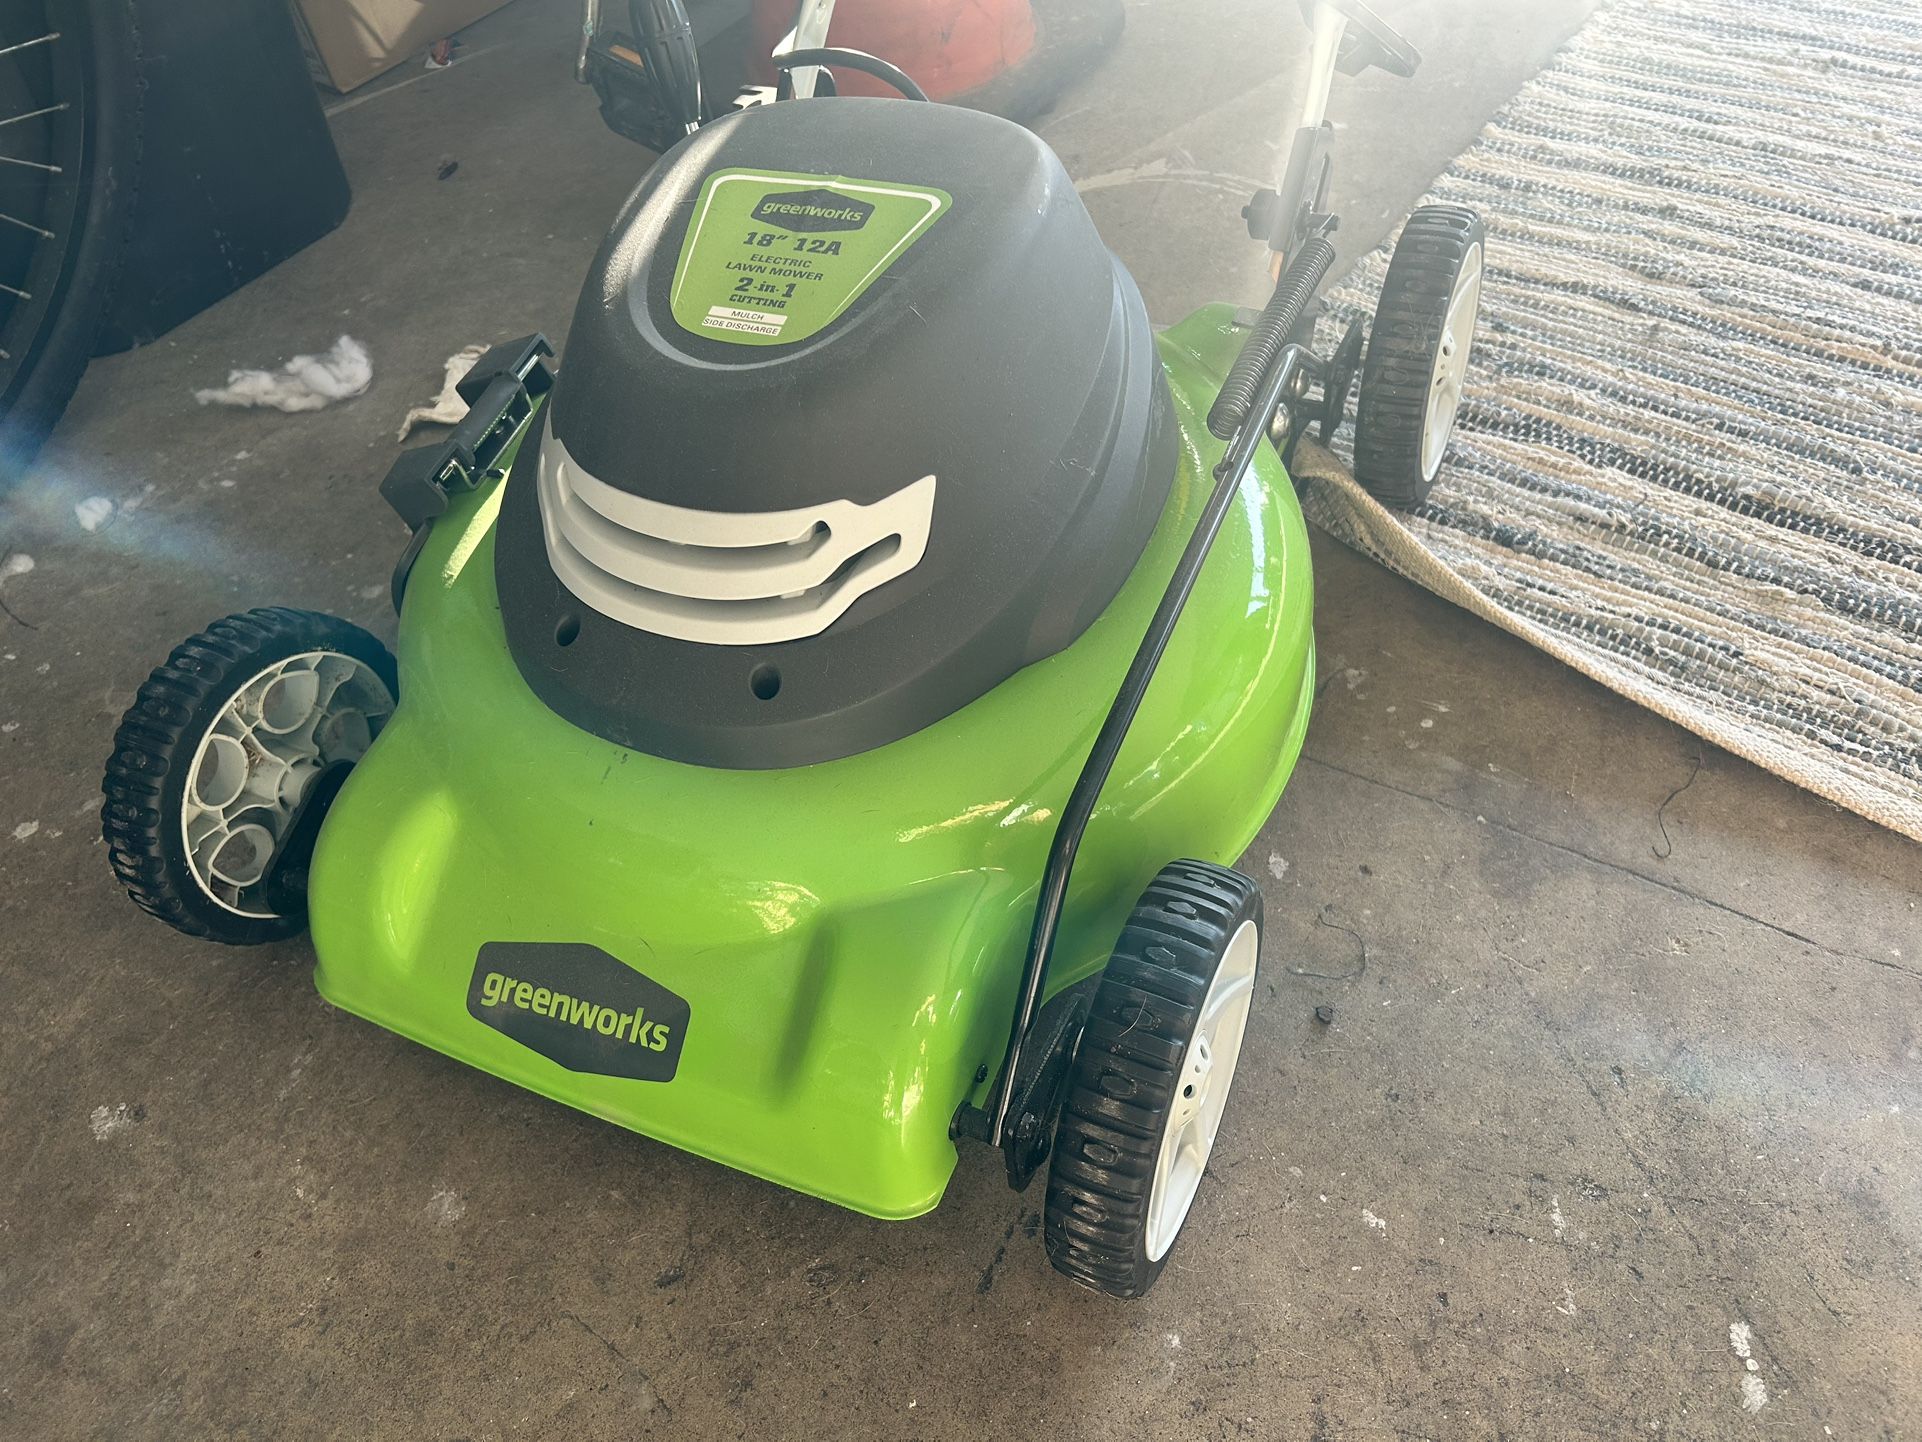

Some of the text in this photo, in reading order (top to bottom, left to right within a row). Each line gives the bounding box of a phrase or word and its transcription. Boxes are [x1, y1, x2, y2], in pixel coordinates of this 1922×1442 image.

[760, 202, 864, 222] greenworks
[793, 237, 842, 256] 12A
[750, 253, 812, 269] ELECTRIC
[725, 261, 824, 281] LAWN MOWER
[729, 294, 787, 309] CUTTING
[731, 310, 765, 321] MULCH
[703, 318, 780, 335] SIDE DISCHARGE
[480, 971, 670, 1052] greenworks
